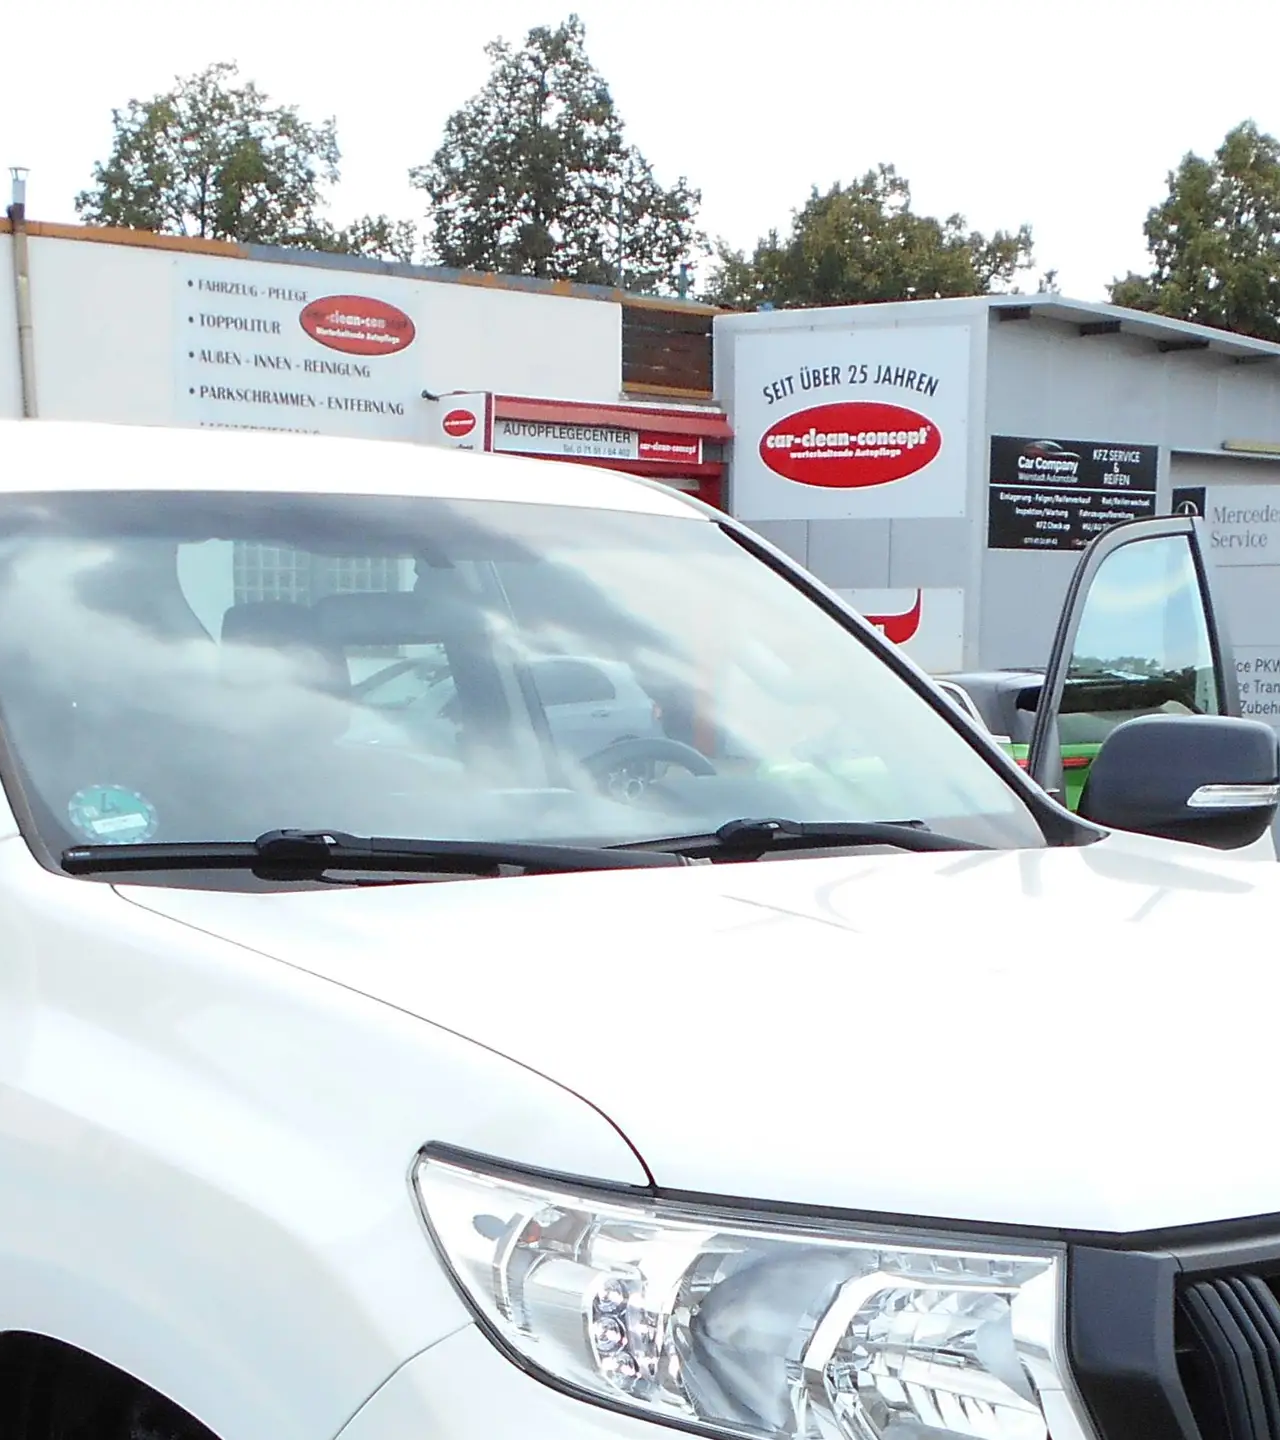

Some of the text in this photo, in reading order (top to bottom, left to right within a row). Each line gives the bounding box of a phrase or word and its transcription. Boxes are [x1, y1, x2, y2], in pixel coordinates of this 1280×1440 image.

[198, 279, 258, 298] FAHRZEUG
[269, 287, 309, 303] PFLEGE
[199, 313, 282, 335] TOPPOLITUR
[254, 354, 292, 371] INNEN
[304, 359, 371, 378] REINIGUNG
[763, 364, 940, 405] SEIT ÜBER 25 JAHREN
[199, 385, 317, 408] PARKSCHRAMMEN
[327, 396, 405, 416] ENTFERNUNG
[503, 422, 631, 444] AUTOPFLEGECENTER
[766, 426, 928, 449] car-clean-concept
[1018, 455, 1079, 475] Car Company
[1092, 448, 1141, 463] KFZ SERVICE
[1103, 473, 1131, 486] REIFEN
[1210, 530, 1268, 549] Service
